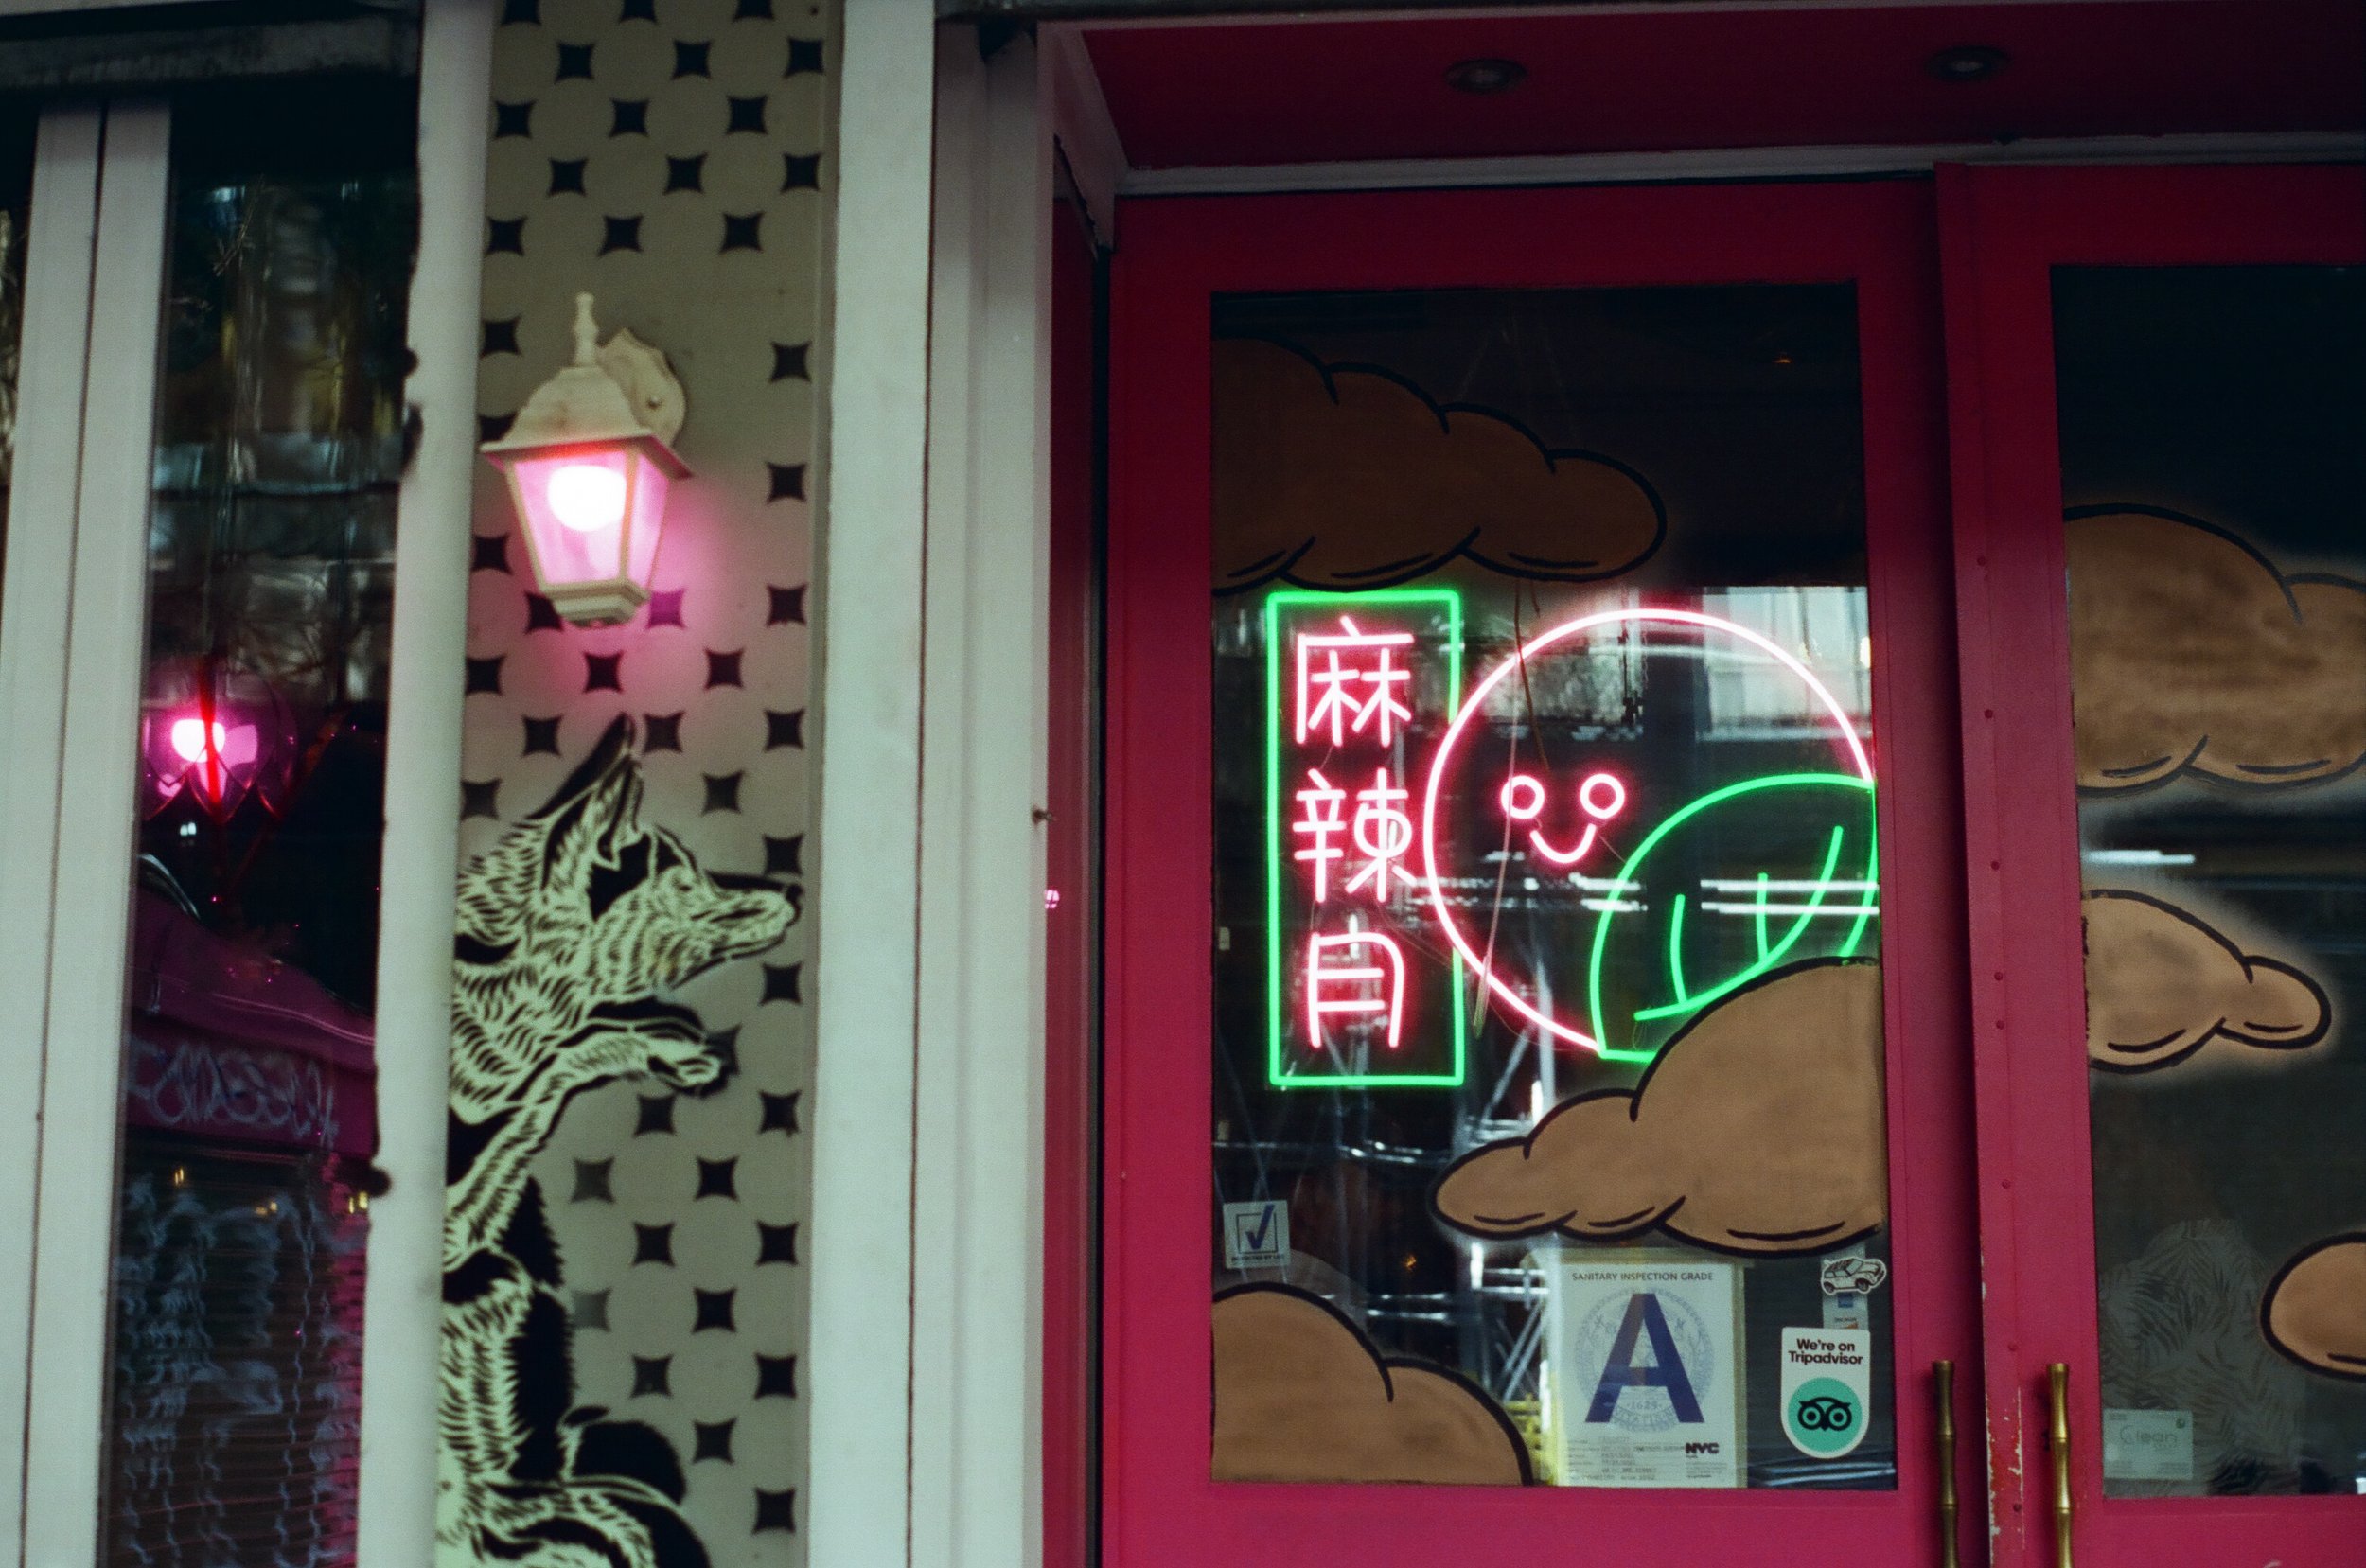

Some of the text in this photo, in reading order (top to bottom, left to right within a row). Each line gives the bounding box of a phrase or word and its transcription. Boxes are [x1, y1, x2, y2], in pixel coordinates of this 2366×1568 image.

[1572, 1272, 1713, 1281] SANITARY INSPECTION GRADE
[1796, 1338, 1856, 1352] We're on
[1585, 1293, 1704, 1423] A
[1788, 1351, 1863, 1365] Tripadvisor
[1685, 1442, 1721, 1454] NYC
